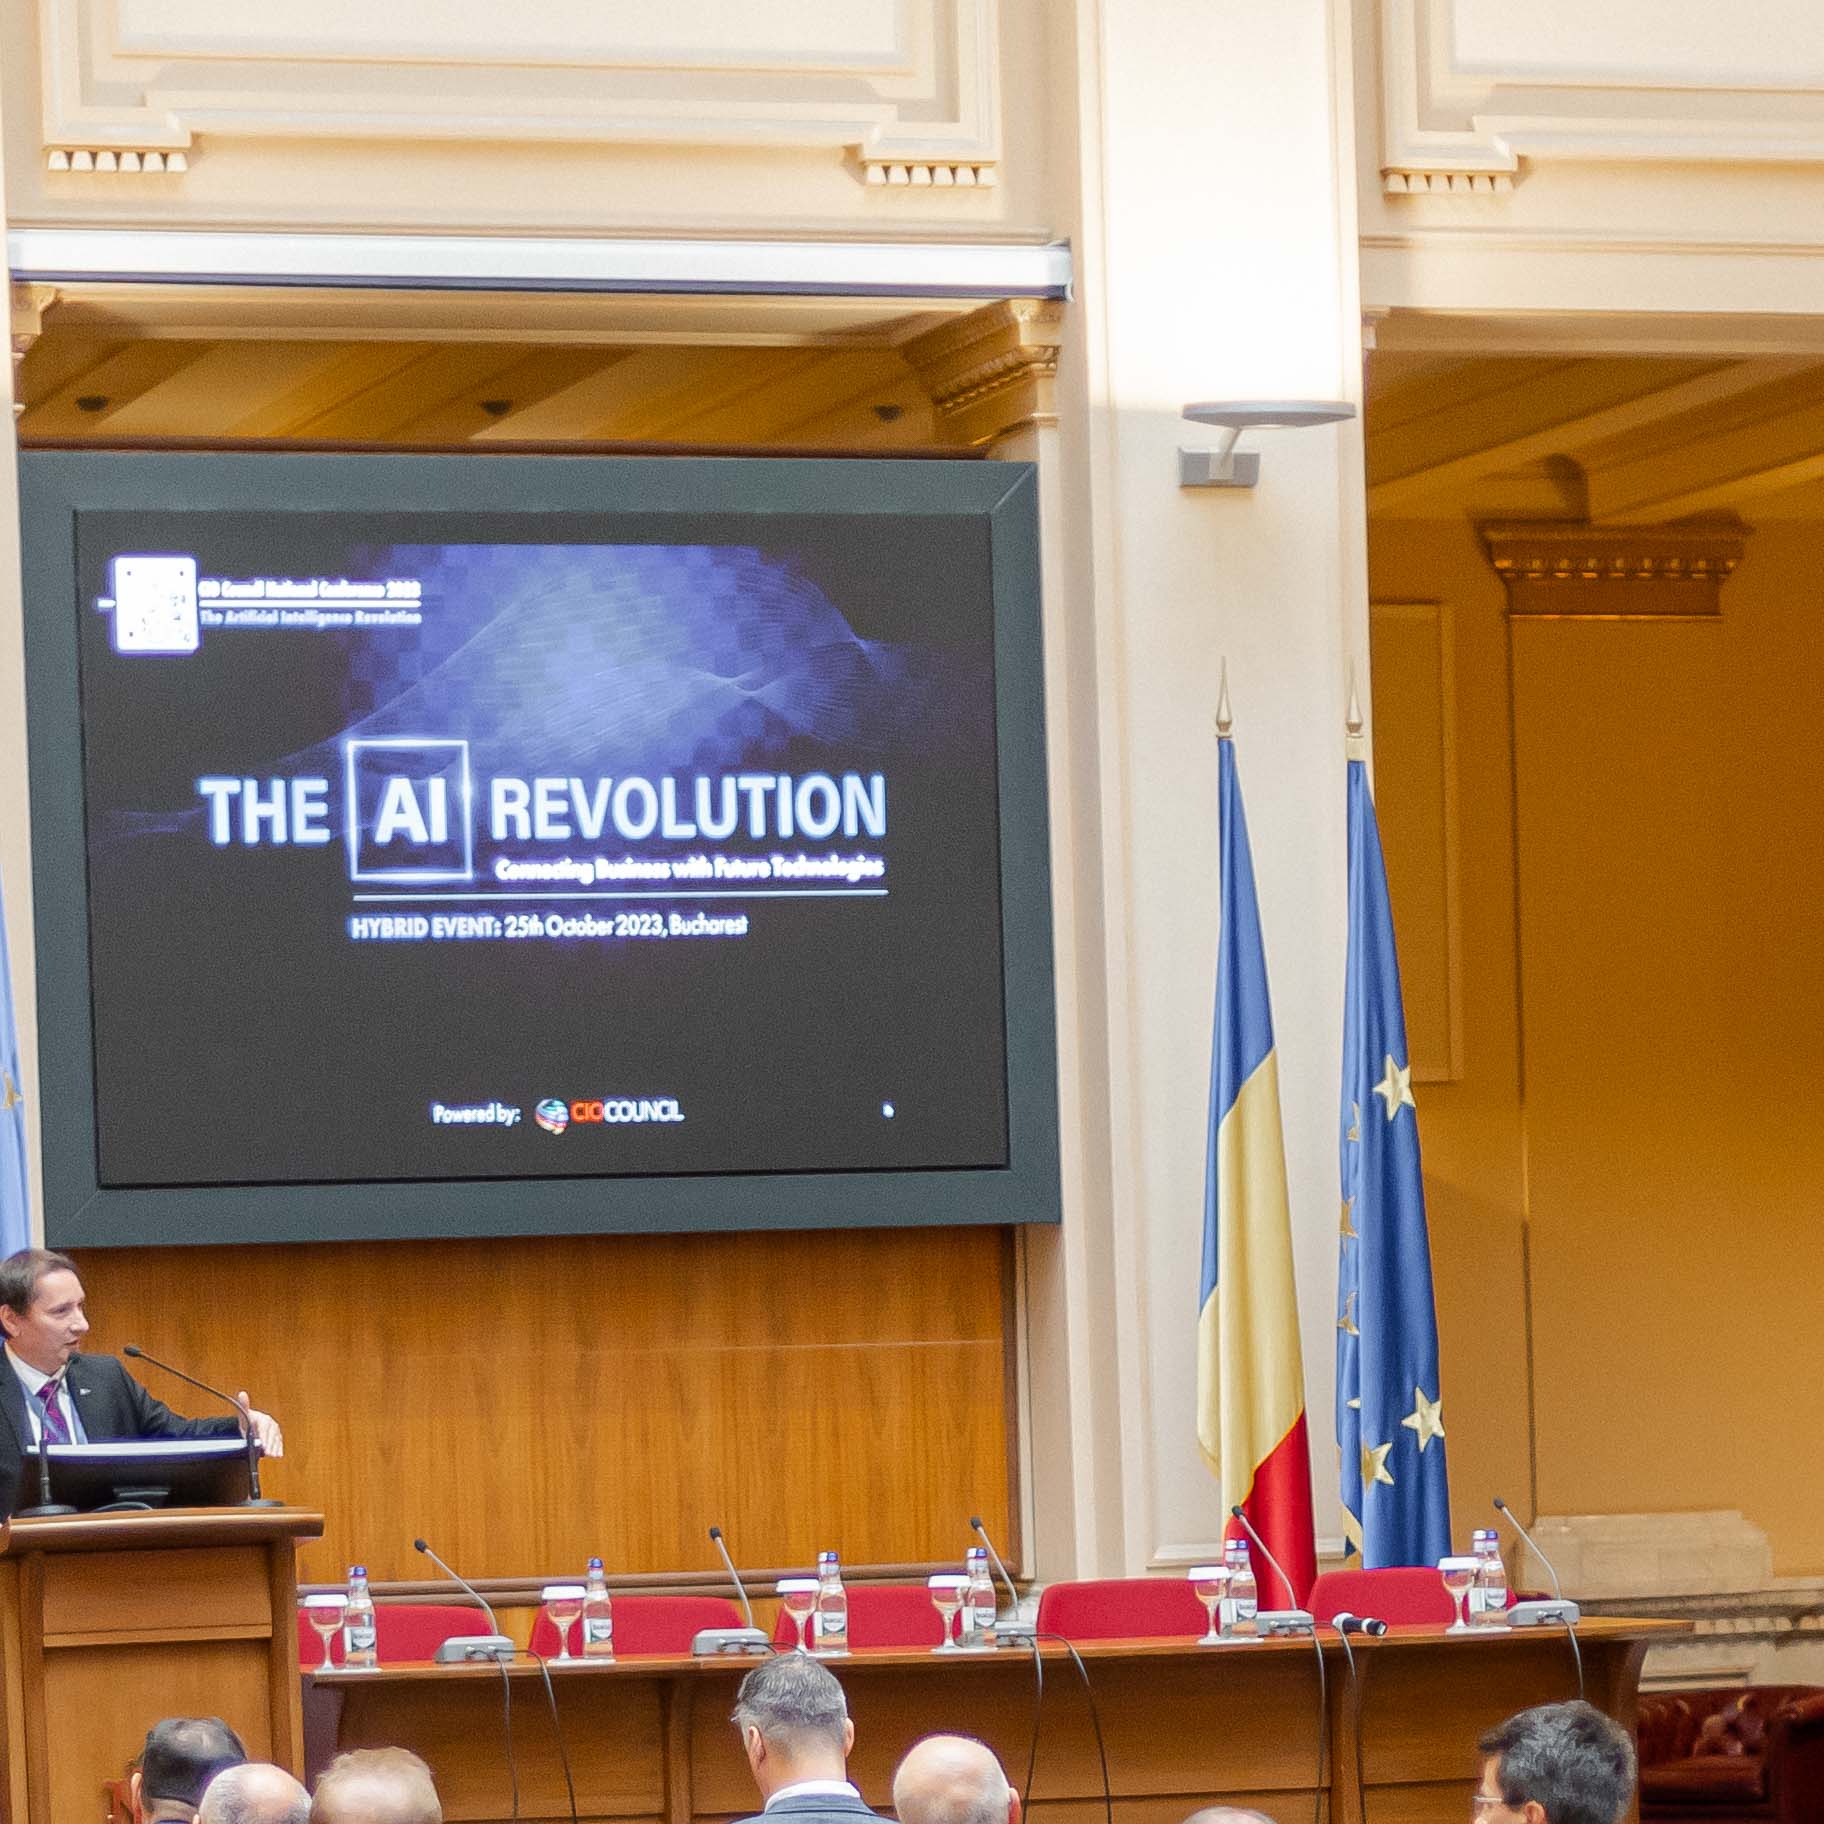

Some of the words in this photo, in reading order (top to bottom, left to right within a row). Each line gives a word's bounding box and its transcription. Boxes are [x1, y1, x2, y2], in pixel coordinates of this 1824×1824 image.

[196, 776, 331, 845] THE
[374, 777, 449, 844] AI
[491, 775, 887, 840] REVOLUTION
[672, 854, 713, 879] with
[713, 855, 771, 879] Future
[351, 915, 429, 938] HYBRID
[431, 915, 502, 938] EVENT:
[503, 913, 544, 938] 25th
[545, 912, 614, 937] October
[614, 913, 668, 938] 2023,
[668, 911, 749, 936] Bucharest
[432, 1104, 494, 1124] Powered
[496, 1104, 521, 1126] by:
